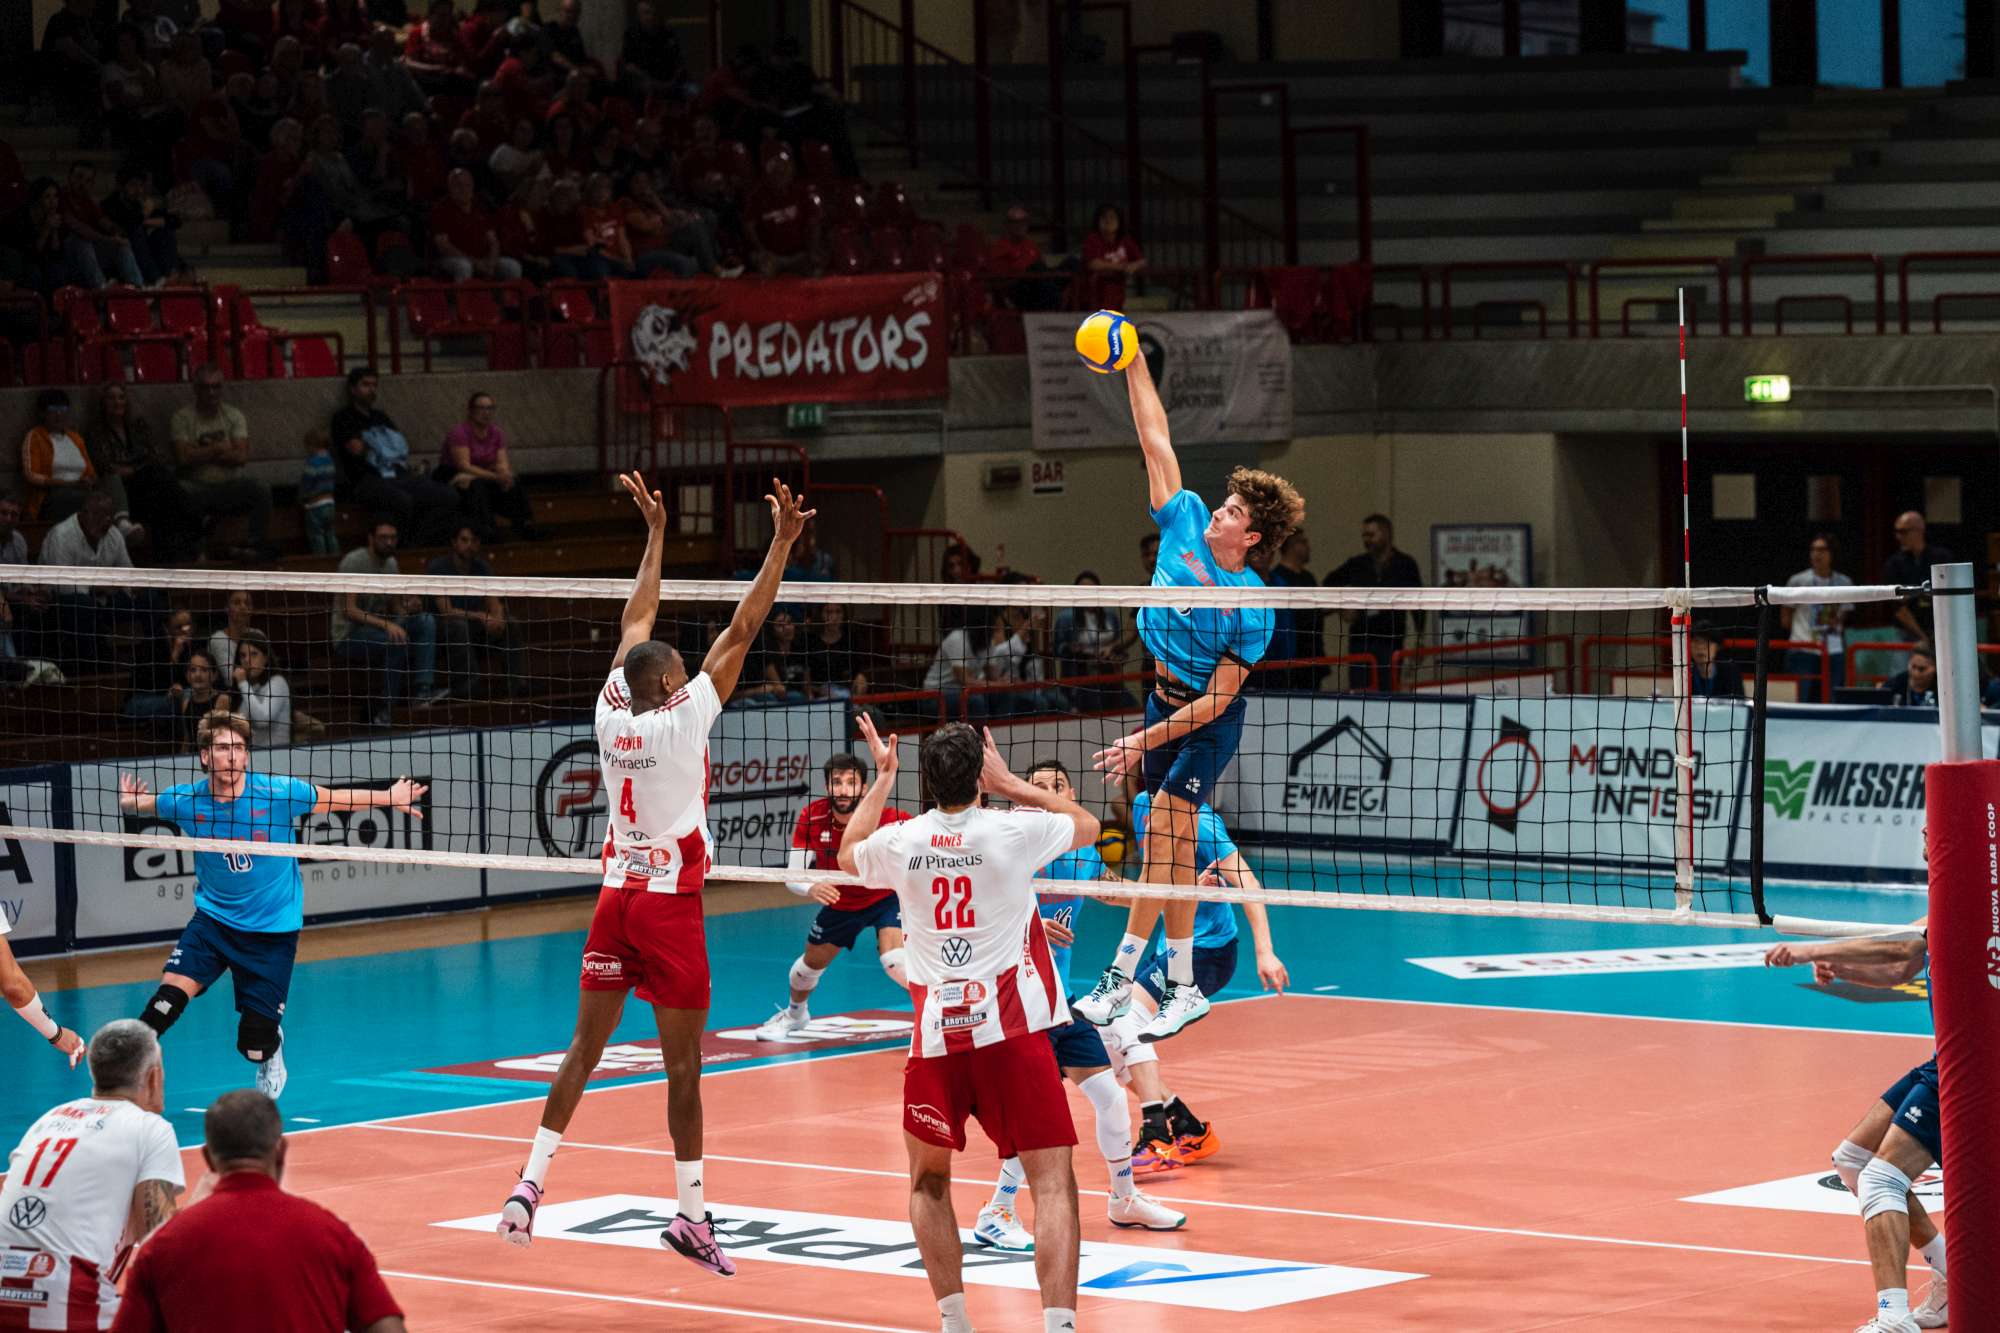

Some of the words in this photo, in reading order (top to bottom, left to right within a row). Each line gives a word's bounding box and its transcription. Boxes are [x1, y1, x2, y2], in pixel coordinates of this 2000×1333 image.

[709, 311, 932, 380] PREDATORS
[1032, 462, 1063, 483] BAR
[611, 754, 657, 770] Piraeus
[709, 754, 809, 787] RGOLESI
[620, 777, 637, 824] 4
[1281, 784, 1389, 812] EMMEGI
[1592, 783, 1723, 821] INFISSI
[716, 809, 797, 842] SPORTI
[1808, 811, 1916, 826] PACKAGI
[1987, 803, 1996, 838] COOP
[223, 851, 253, 873] 10
[925, 854, 983, 869] Piraeus
[1989, 843, 1998, 885] RADAR
[932, 876, 975, 930] 22
[1991, 889, 2000, 933] NUOVA
[22, 1138, 79, 1188] 17
